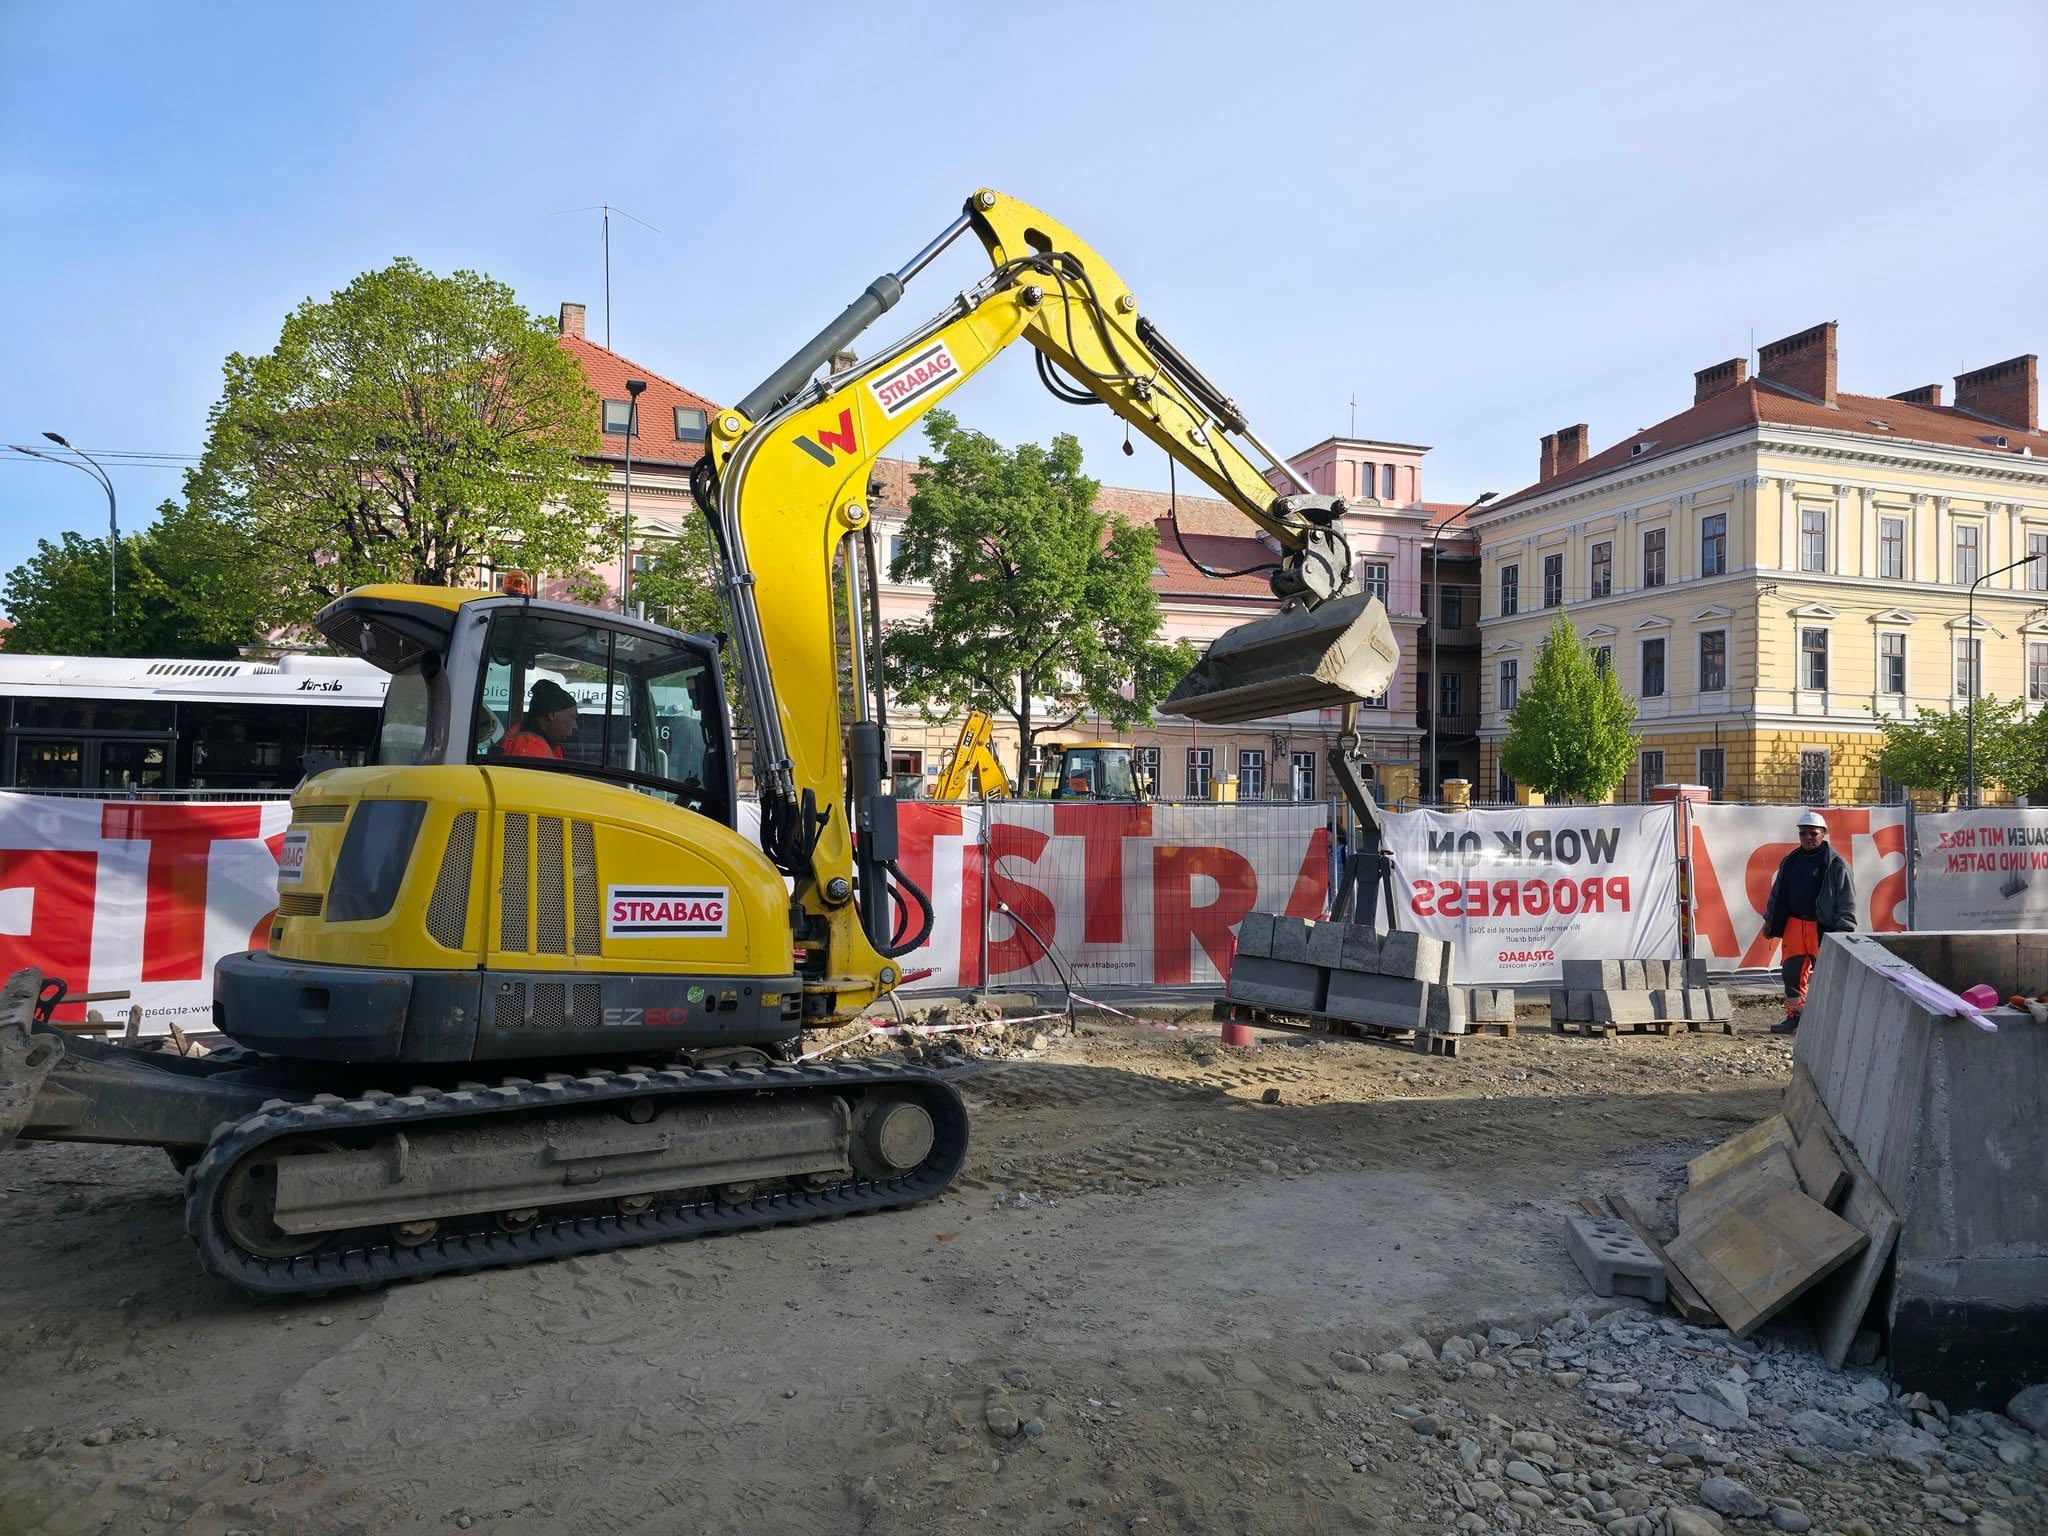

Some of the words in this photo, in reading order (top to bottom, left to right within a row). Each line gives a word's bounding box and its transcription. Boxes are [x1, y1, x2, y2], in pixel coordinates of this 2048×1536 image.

[878, 353, 951, 406] STRABAG
[612, 901, 723, 922] STRABAG
[1071, 962, 1136, 970] www.strabag.com
[602, 1008, 688, 1026] EZ80
